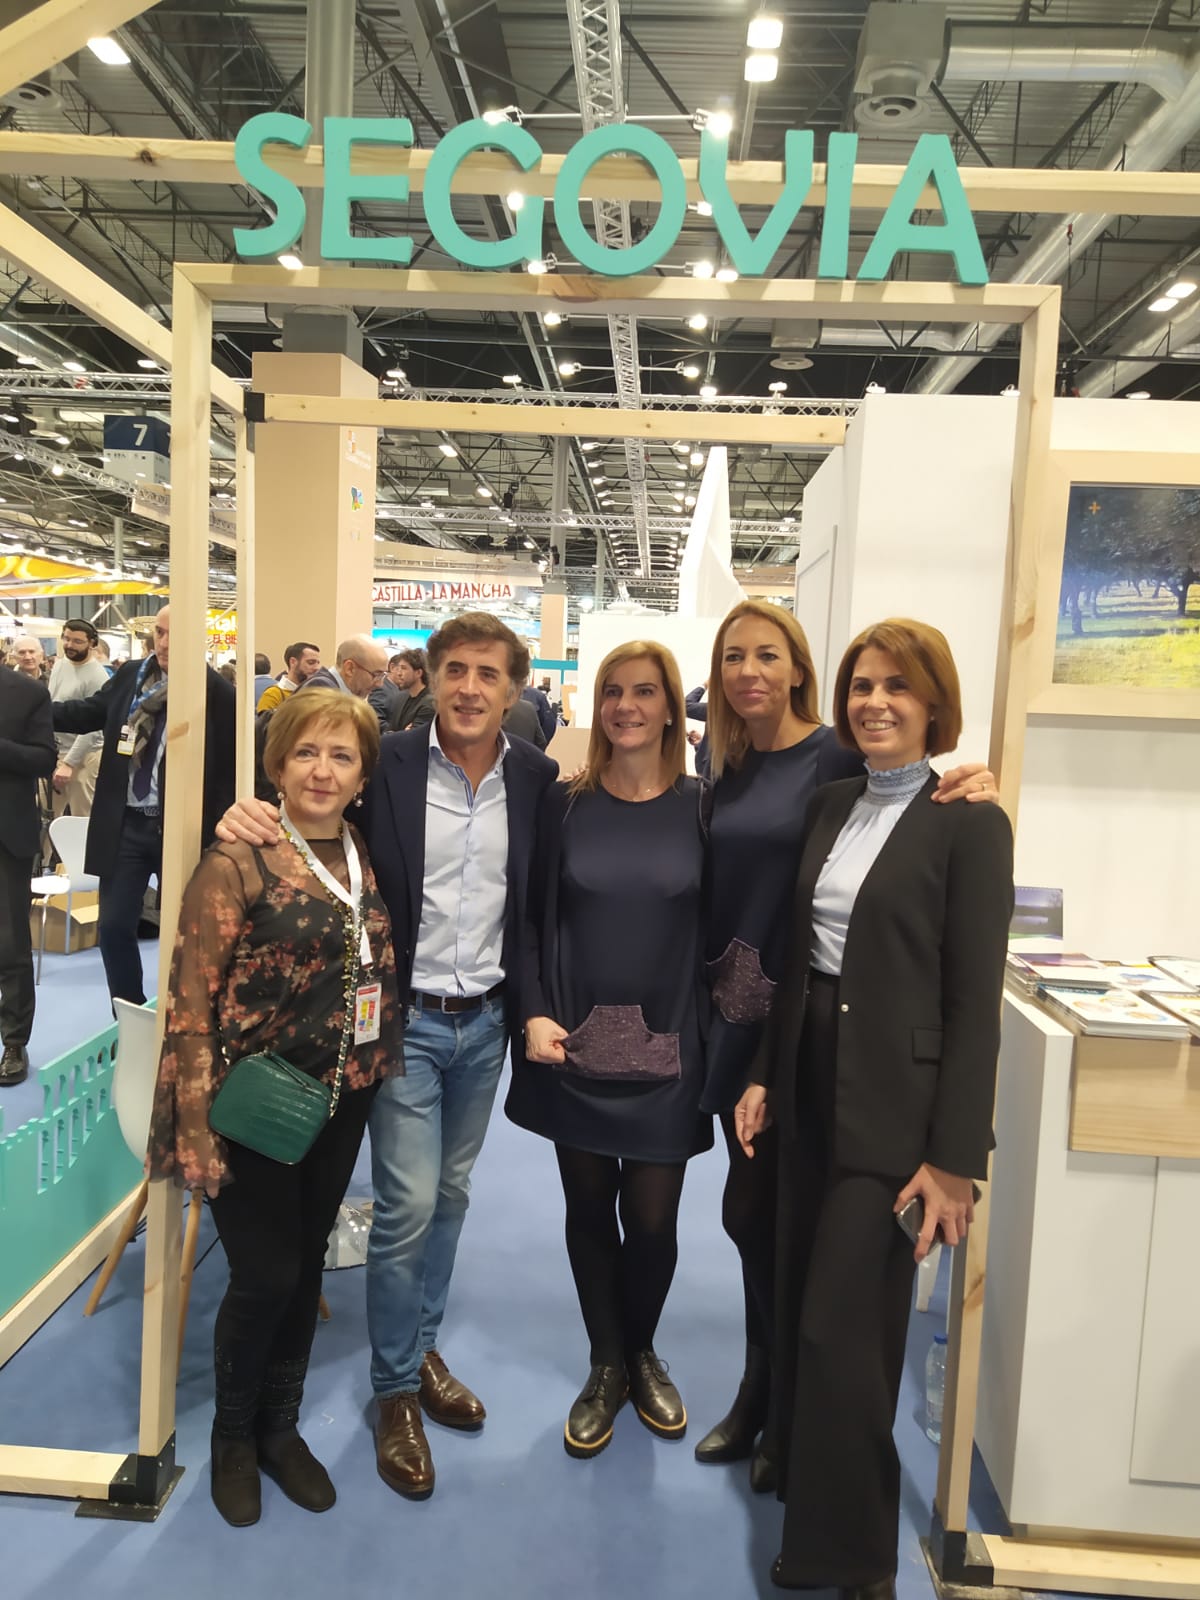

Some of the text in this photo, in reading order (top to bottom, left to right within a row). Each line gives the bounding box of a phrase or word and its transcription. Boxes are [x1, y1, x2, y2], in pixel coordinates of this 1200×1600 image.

[232, 112, 989, 285] SEGOVIA
[133, 424, 148, 447] 7
[372, 584, 423, 602] CASTILLA
[432, 583, 448, 600] LA
[450, 582, 512, 599] MANCHA
